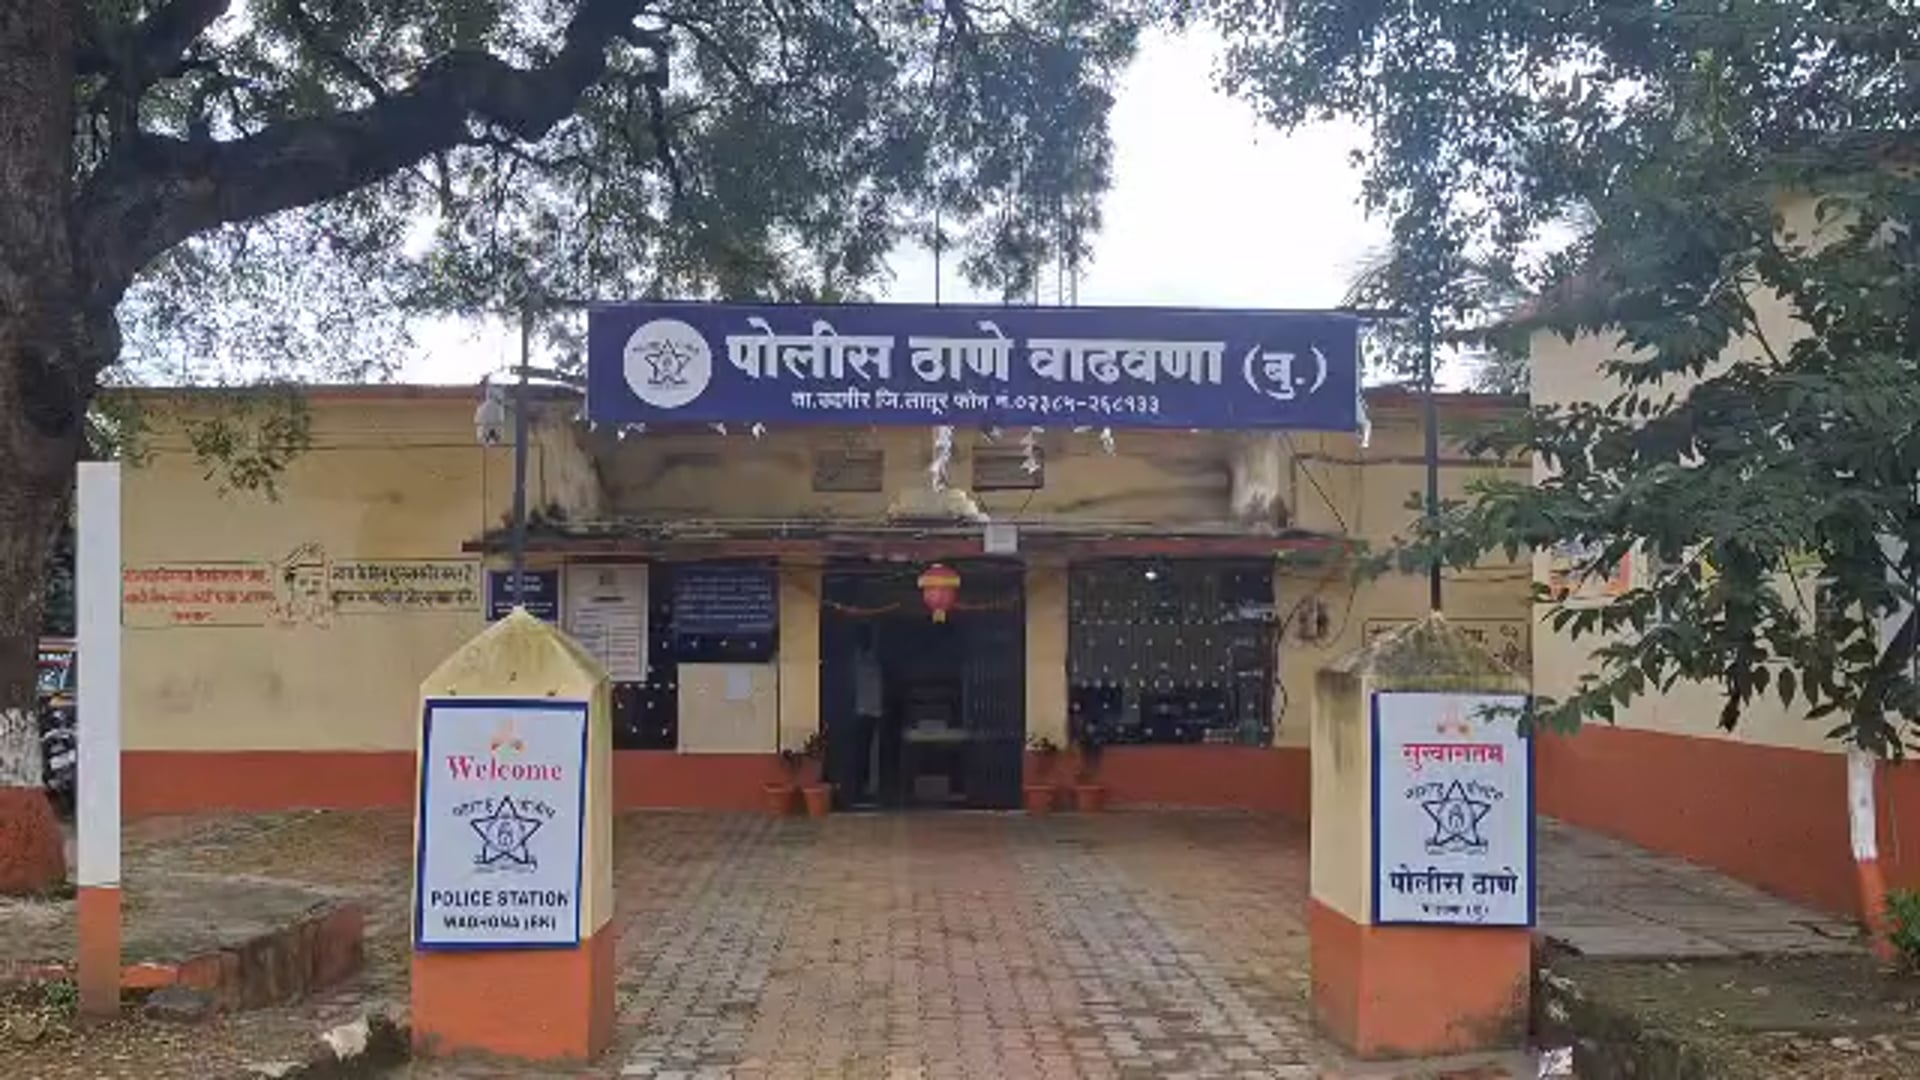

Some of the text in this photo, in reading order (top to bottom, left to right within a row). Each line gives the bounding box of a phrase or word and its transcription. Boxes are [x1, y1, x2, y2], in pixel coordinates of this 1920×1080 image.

[725, 317, 1328, 400] पोलीस ठाणे वाढवणा (बु.)
[953, 389, 989, 410] फोन
[446, 755, 562, 781] Welcome
[1389, 863, 1519, 895] पोलीस ठाणे
[431, 890, 568, 907] POLICE STATION
